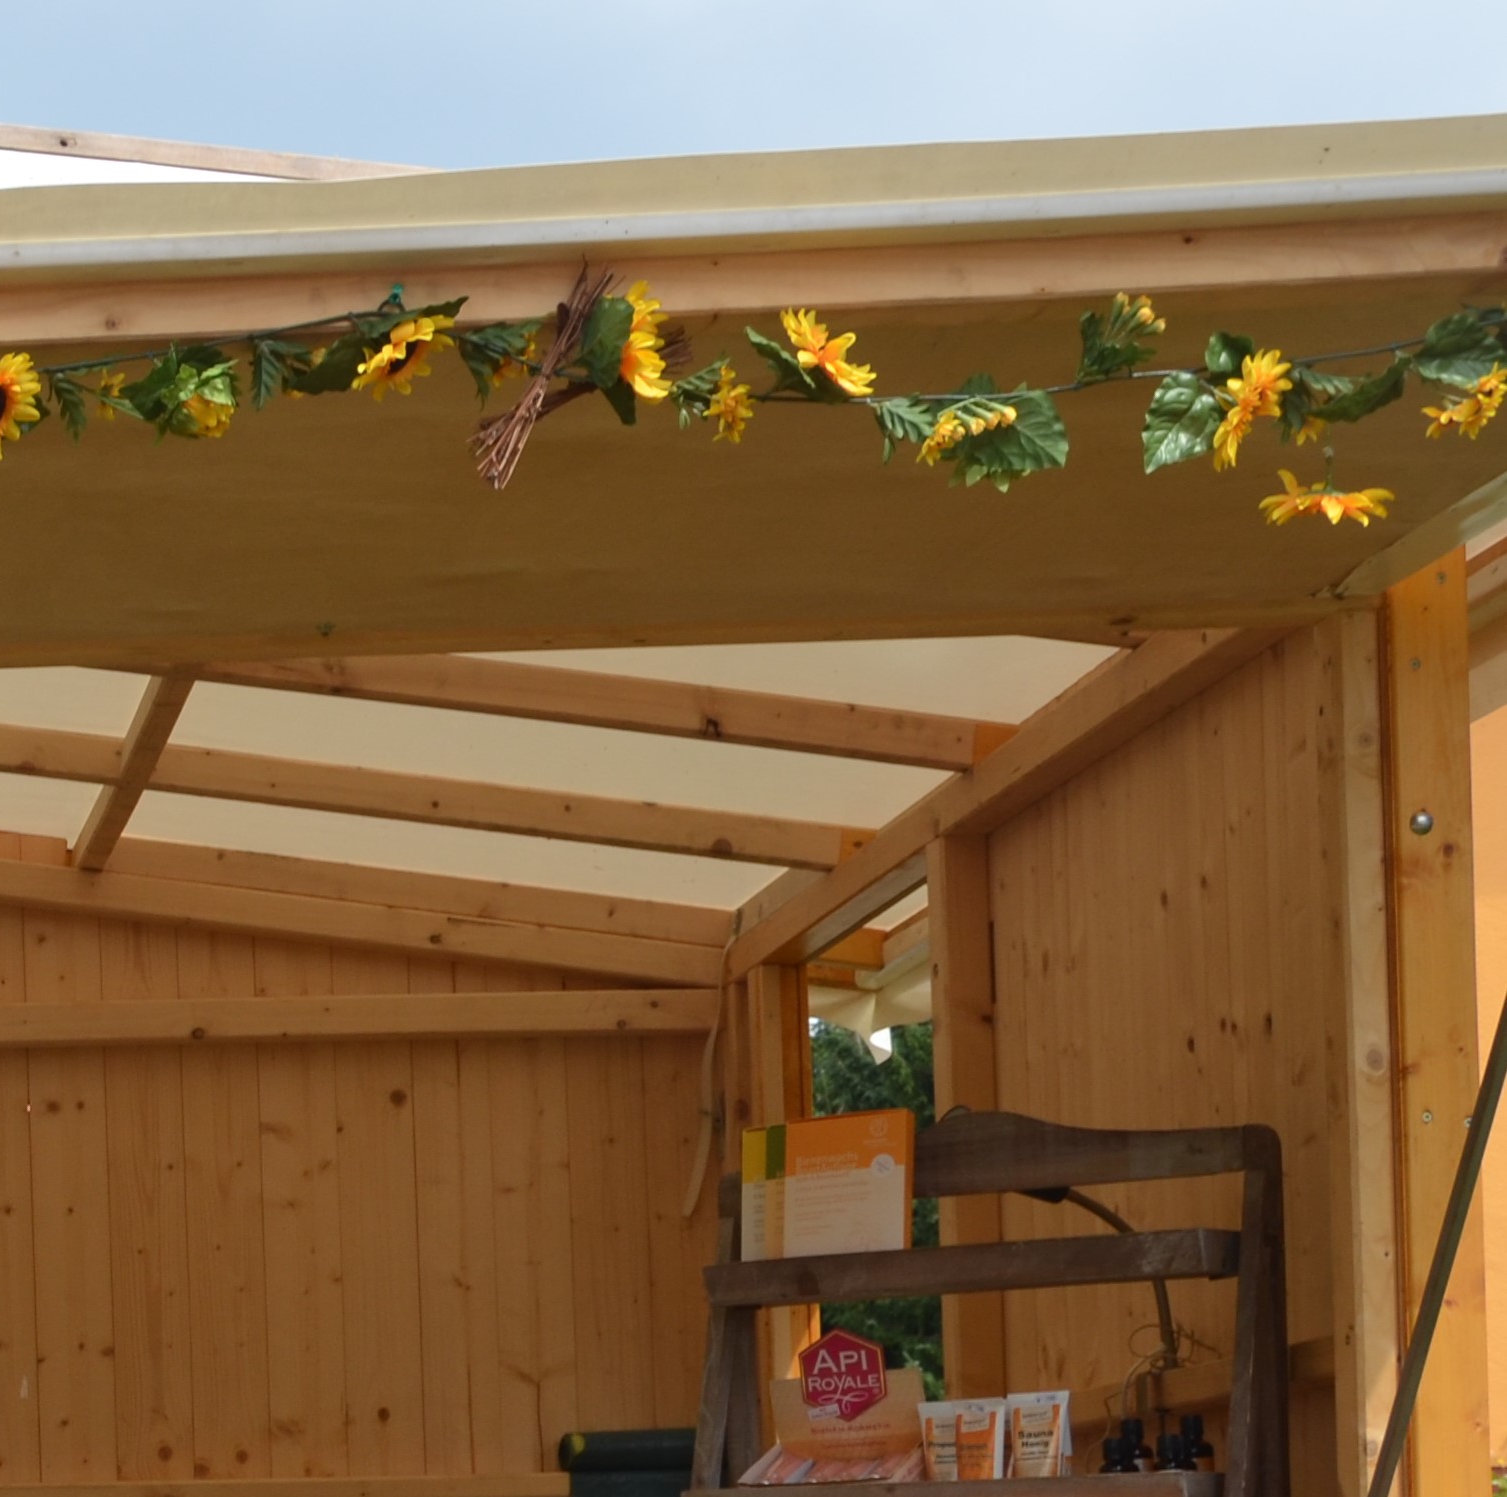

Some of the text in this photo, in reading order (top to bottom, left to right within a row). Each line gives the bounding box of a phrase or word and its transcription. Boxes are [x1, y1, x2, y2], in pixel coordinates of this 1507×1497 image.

[812, 1348, 868, 1375] API
[807, 1374, 881, 1394] ROYALE
[1018, 1429, 1054, 1440] Sauna
